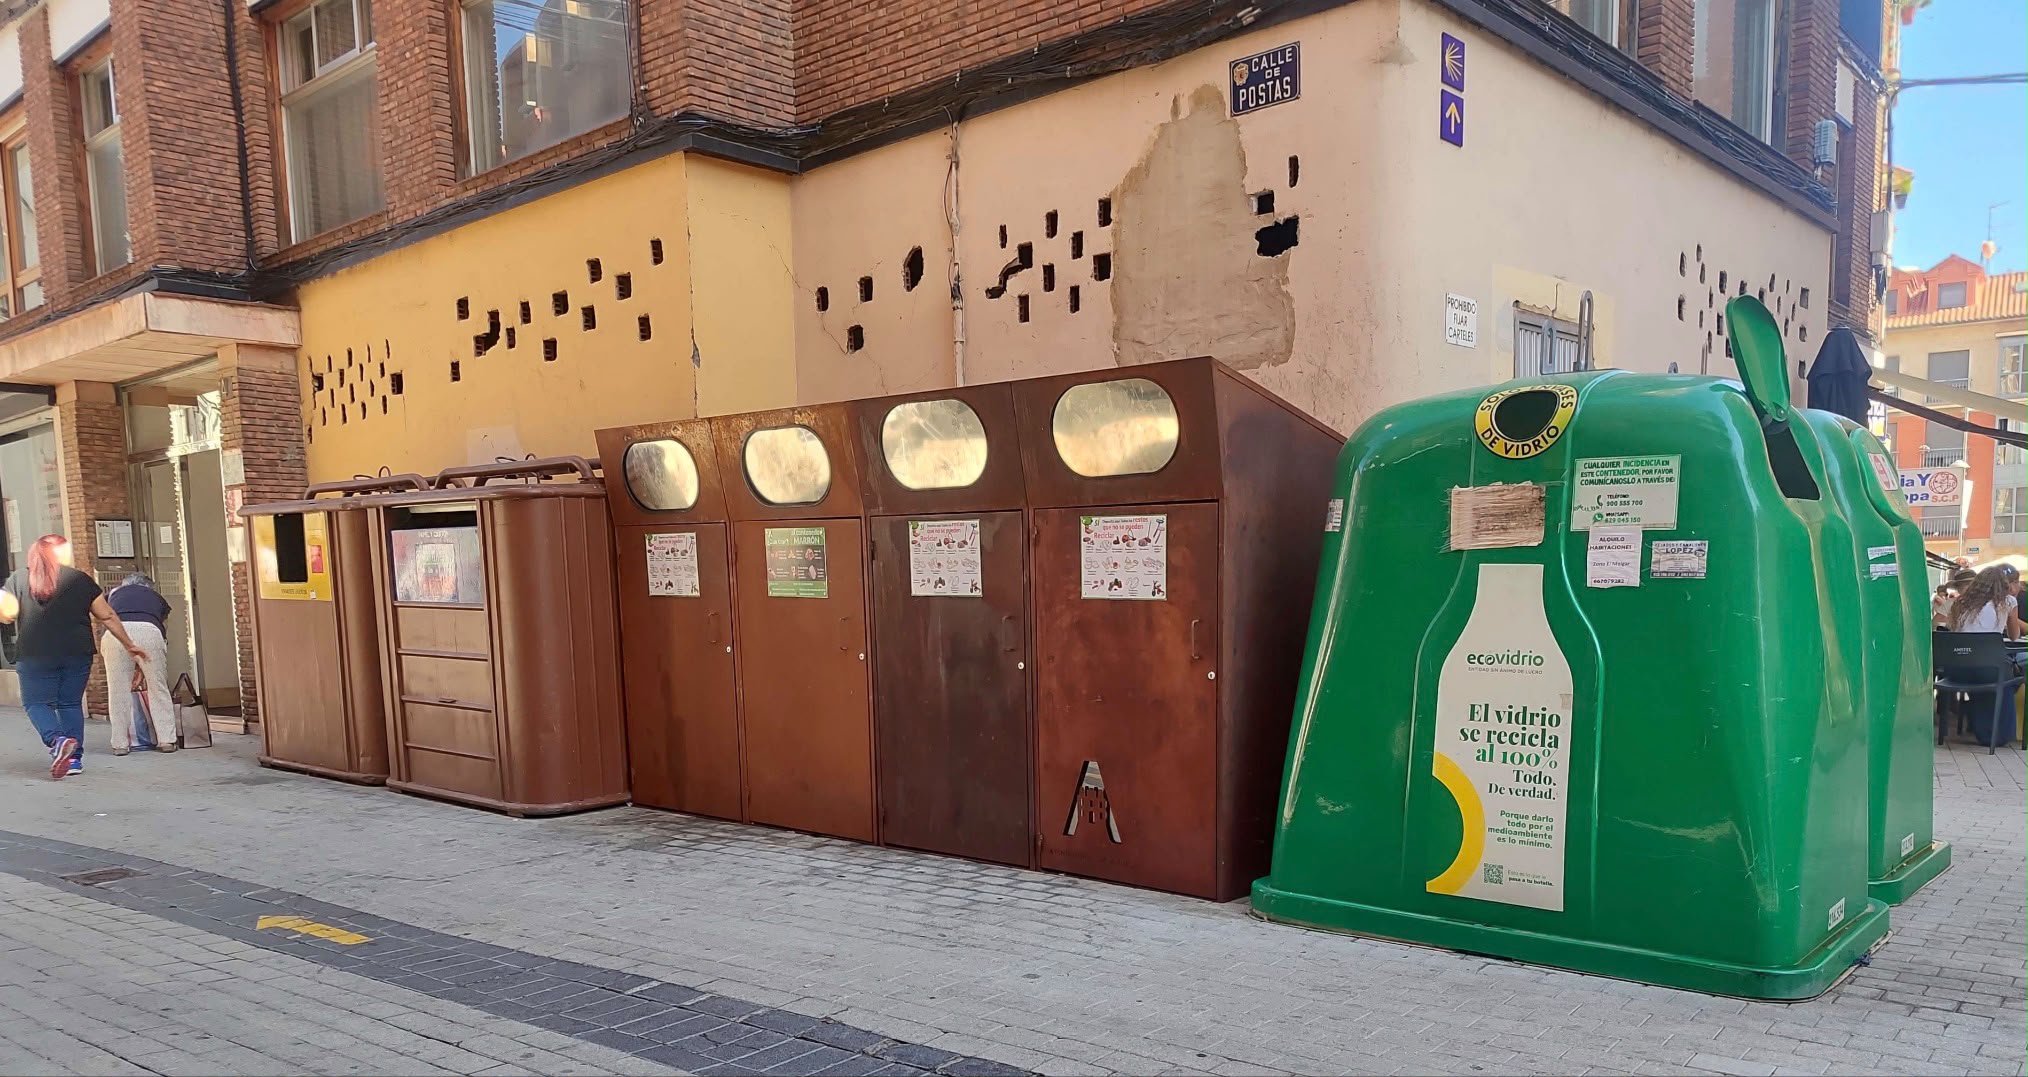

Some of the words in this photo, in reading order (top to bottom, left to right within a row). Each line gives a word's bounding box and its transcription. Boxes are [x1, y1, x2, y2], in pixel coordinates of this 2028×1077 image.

[1252, 48, 1293, 72] CALLE
[1265, 67, 1280, 79] DE
[1240, 76, 1291, 110] POSTAS
[1453, 313, 1468, 327] FIJAR
[1448, 326, 1474, 342] CARTELES
[1481, 428, 1500, 449] DE
[1503, 425, 1559, 457] VIDRIO
[1583, 461, 1621, 469] CUALQUIER
[1623, 459, 1661, 468] INCIDENCIA
[1917, 473, 1931, 486] Y
[1467, 649, 1544, 667] ecovidrio
[1469, 703, 1489, 722] El
[1495, 705, 1561, 728] vidrio
[1459, 728, 1481, 742] se
[1486, 727, 1559, 749] recicla
[1475, 744, 1494, 763] al
[1501, 748, 1559, 769] 100%
[1512, 769, 1557, 786] Todo.
[1488, 783, 1505, 795] De
[1508, 786, 1556, 800] verdad.
[1500, 810, 1529, 820] Porque
[1531, 814, 1554, 823] darlo
[1487, 827, 1553, 840] medioambiente
[1507, 820, 1526, 828] todo
[1529, 823, 1543, 831] por
[1519, 839, 1553, 849] mínimo.
